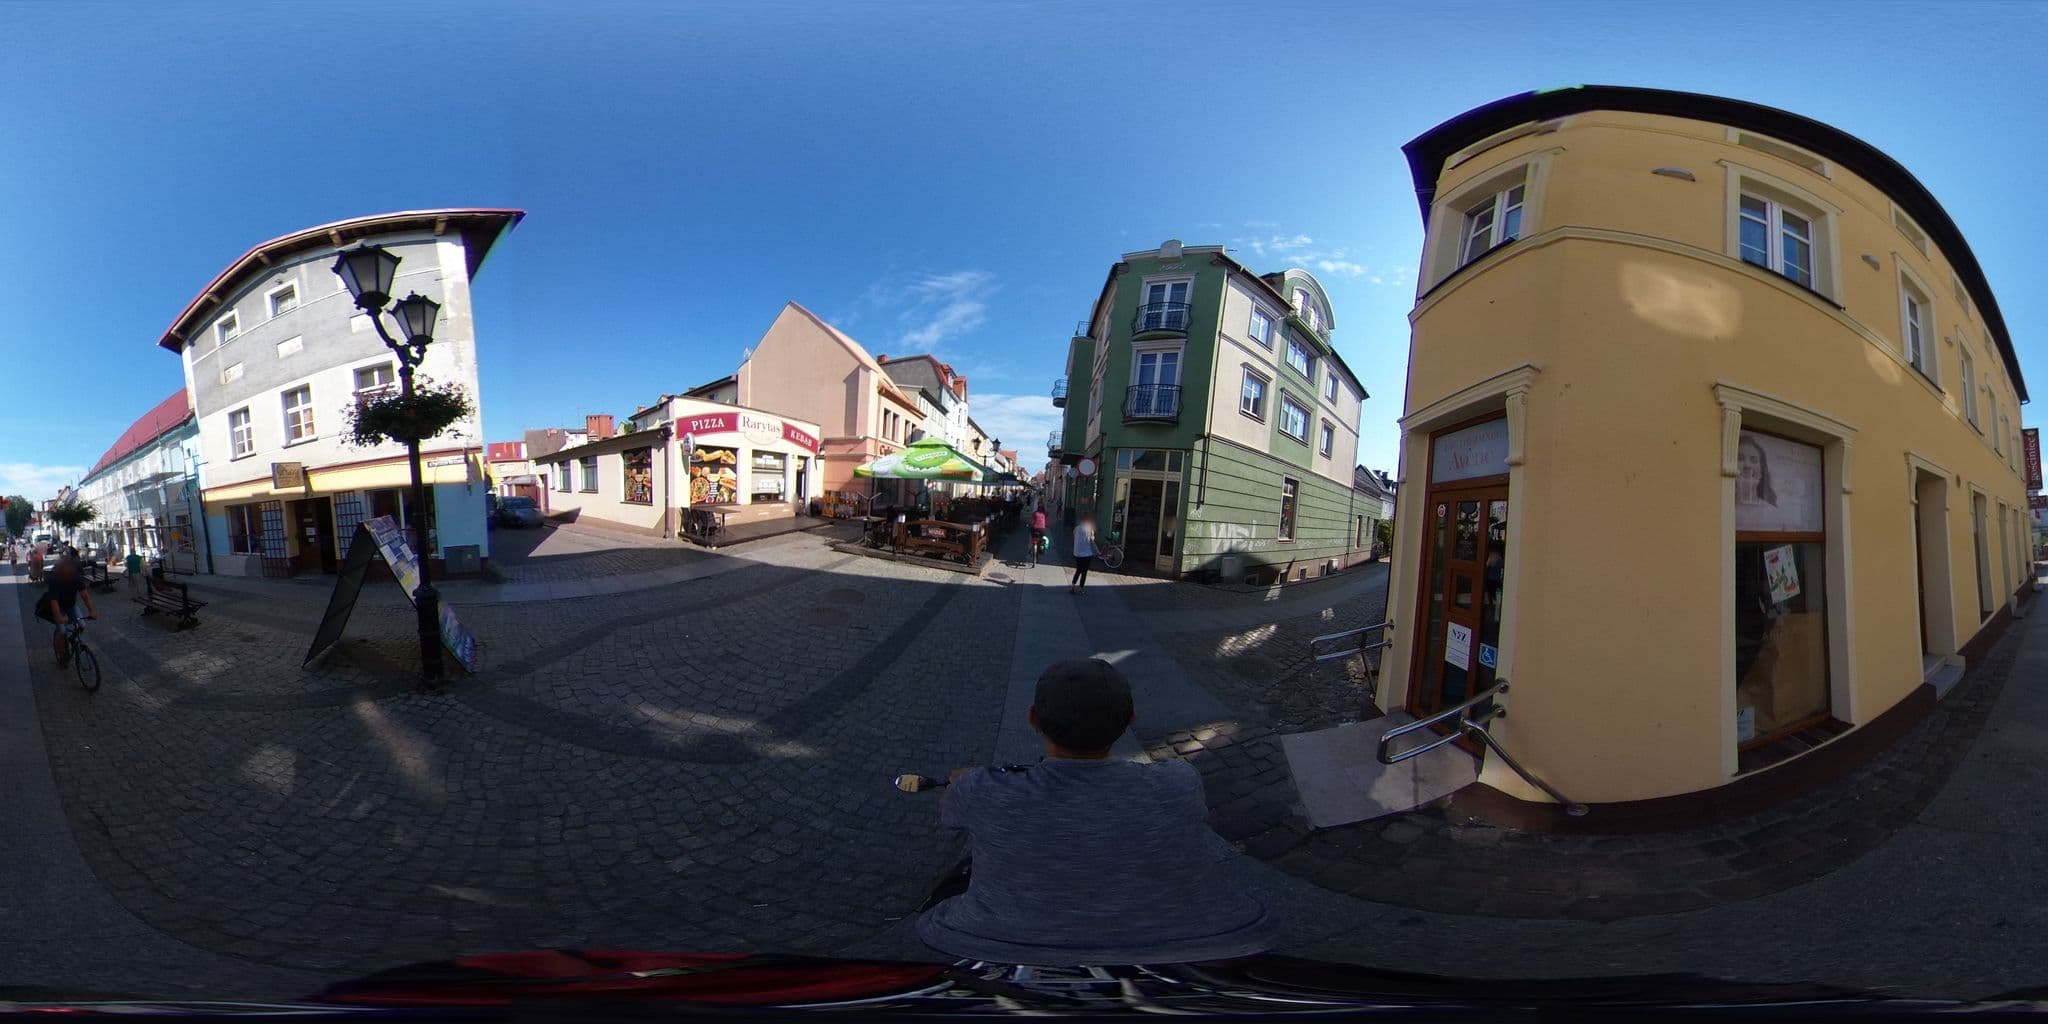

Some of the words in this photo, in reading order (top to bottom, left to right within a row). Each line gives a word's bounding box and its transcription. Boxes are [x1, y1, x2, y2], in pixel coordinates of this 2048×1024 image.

[691, 418, 725, 430] PIZZA
[743, 415, 781, 432] Rarytas
[790, 429, 813, 446] KEBAB
